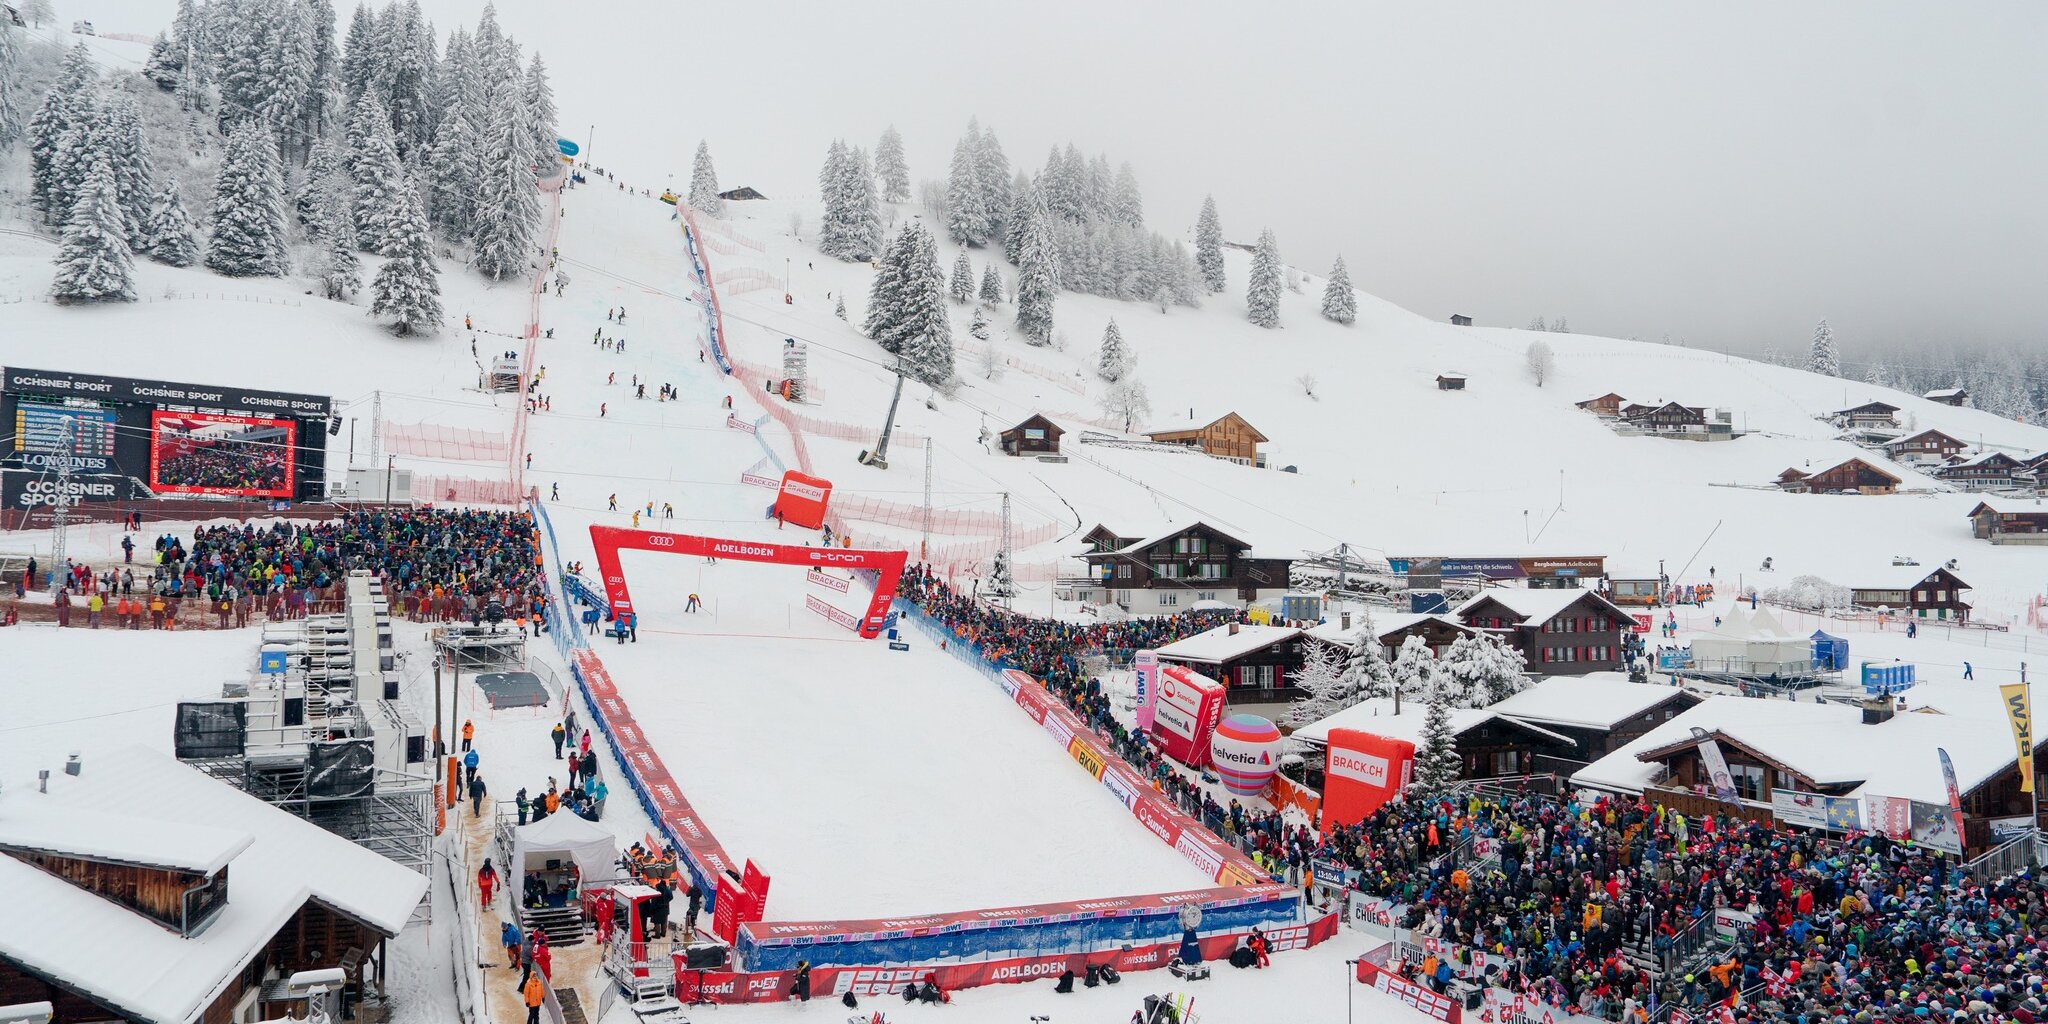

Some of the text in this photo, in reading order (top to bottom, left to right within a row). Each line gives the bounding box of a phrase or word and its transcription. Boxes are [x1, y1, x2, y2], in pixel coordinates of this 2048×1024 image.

[13, 376, 112, 392] OCHSNER SPORT
[133, 387, 222, 402] OCHSNER SPORT
[241, 397, 322, 410] OCHSNER SPORT
[23, 454, 106, 469] LONGINES
[26, 480, 115, 496] OCHSNER
[744, 476, 776, 488] BRACK.CH
[787, 484, 822, 498] BRACK.CH
[20, 494, 83, 506] SPORT
[714, 543, 773, 557] ADELBODEN
[810, 552, 864, 562] e-tron
[810, 573, 847, 590] BRACK.CH
[1177, 691, 1196, 706] Sunrise
[1158, 708, 1182, 728] helvetia
[2009, 694, 2030, 757] BKW
[1213, 744, 1256, 764] helvetia
[1079, 751, 1099, 776] BKW
[1332, 755, 1383, 778] BRACK.CH
[1104, 777, 1124, 802] helvetia
[1146, 814, 1170, 842] Sunrise
[1177, 840, 1216, 878] RAIFFEISEN
[1318, 870, 1340, 882] 13:10:46
[1401, 941, 1423, 952] ADELBODEN
[1123, 951, 1158, 965] swissski
[991, 961, 1066, 980] ADELBODEN
[689, 982, 734, 994] swissski
